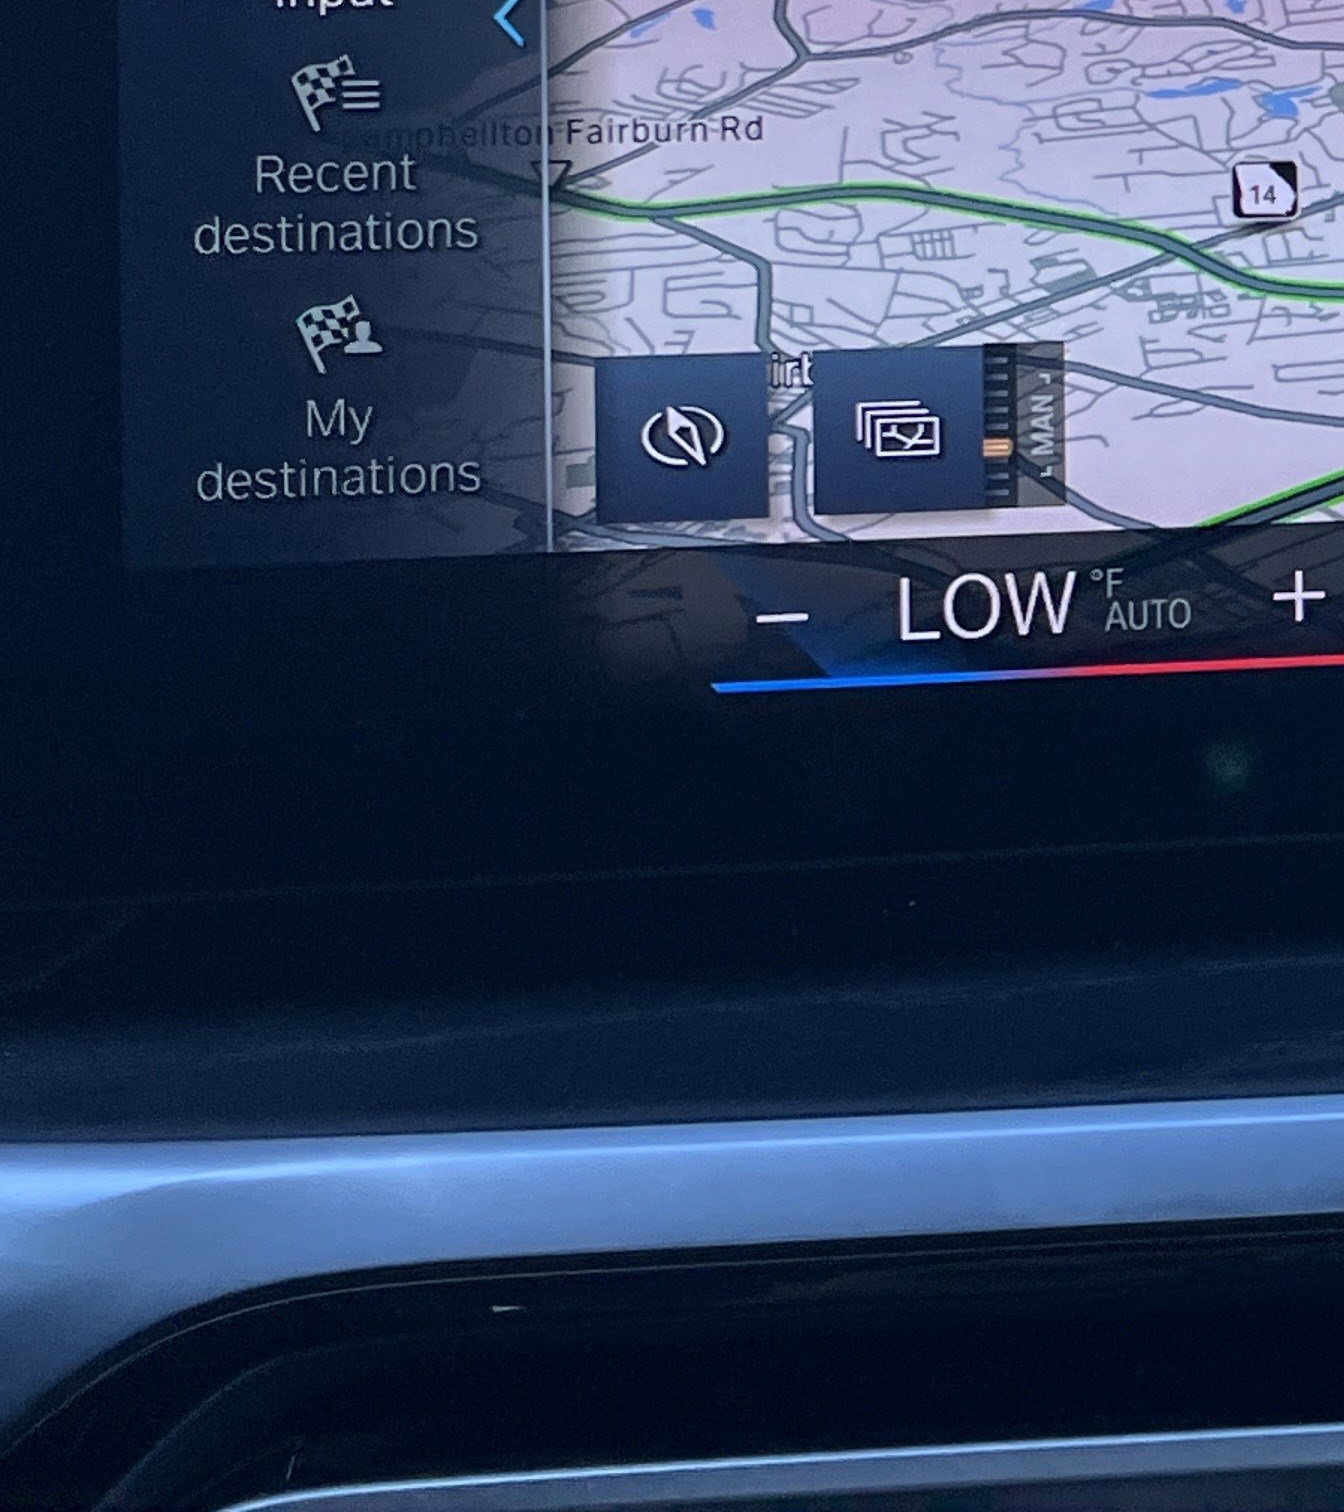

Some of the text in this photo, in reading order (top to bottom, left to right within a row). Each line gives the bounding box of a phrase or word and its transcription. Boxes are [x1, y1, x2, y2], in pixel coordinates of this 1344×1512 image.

[566, 117, 709, 144] Fairburn
[720, 116, 764, 141] Rd
[257, 154, 415, 192] Recent
[1249, 185, 1276, 205] 14
[195, 212, 477, 254] destinations
[307, 399, 372, 444] My
[1032, 394, 1053, 456] MAN
[197, 456, 480, 501] destinations
[900, 571, 1076, 640] LOW
[1105, 598, 1191, 631] AUTO
